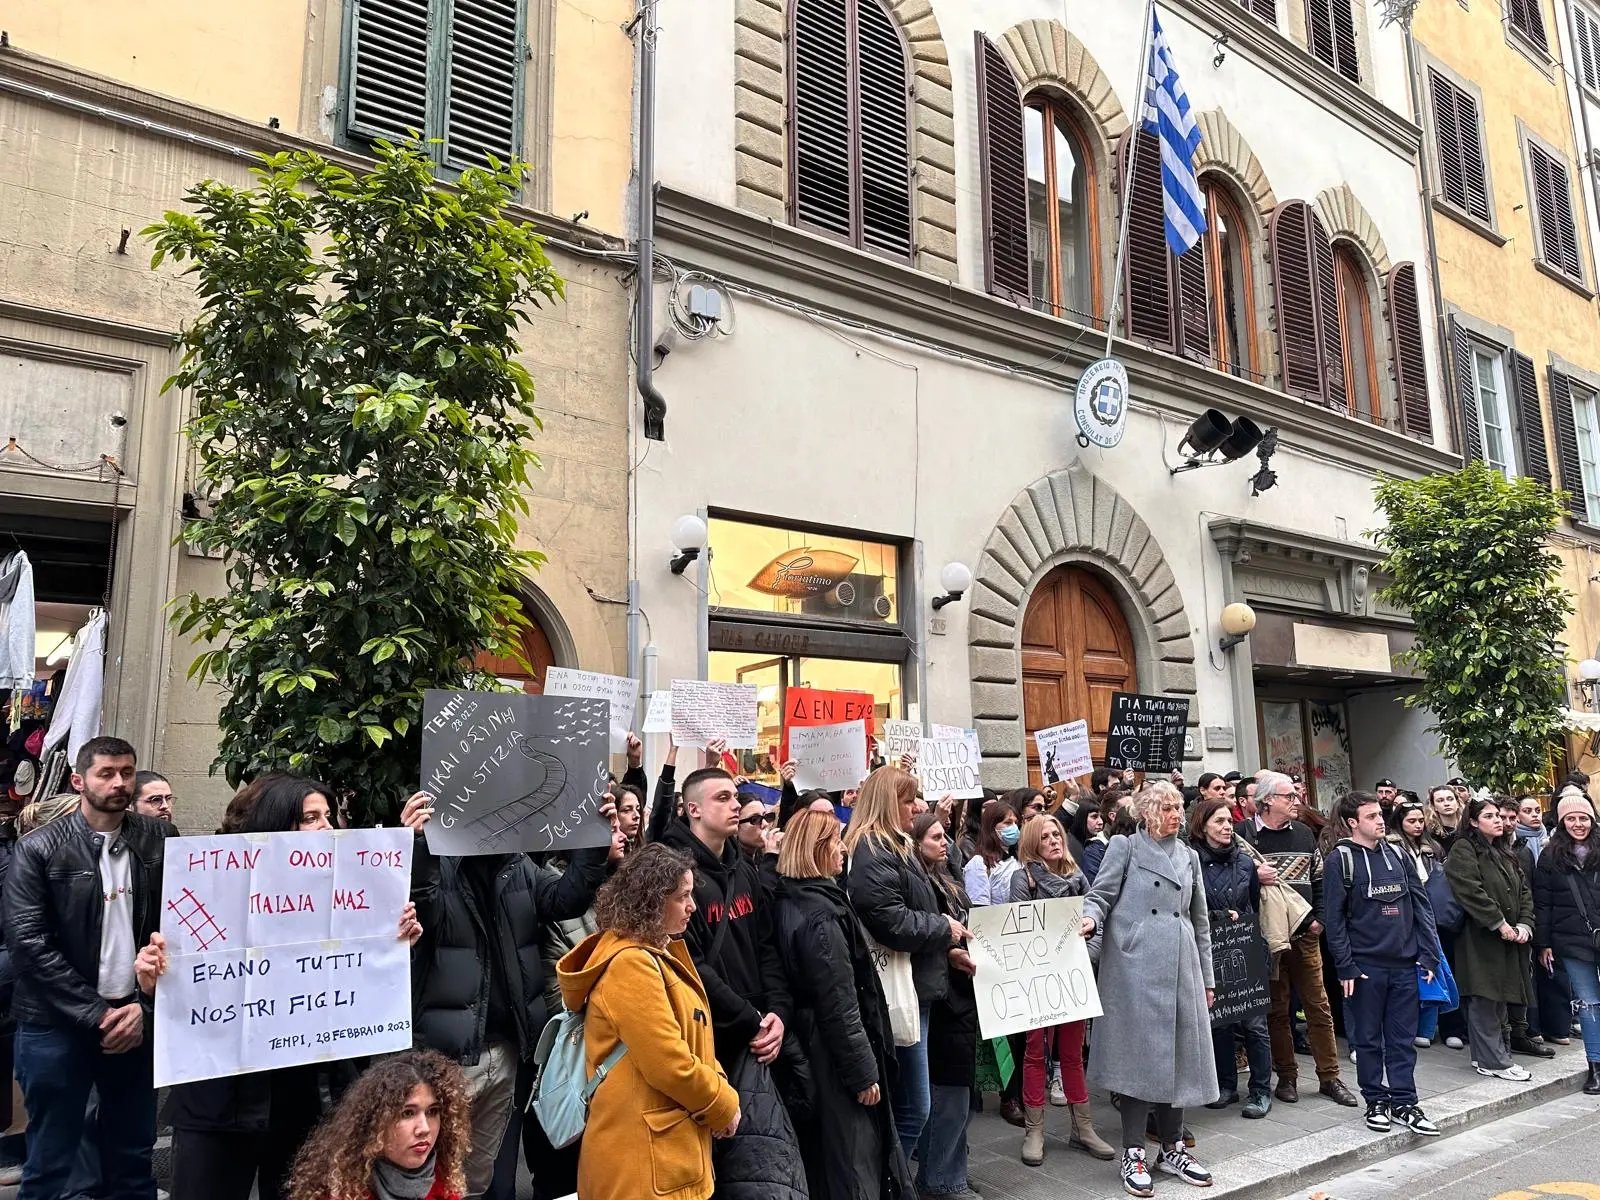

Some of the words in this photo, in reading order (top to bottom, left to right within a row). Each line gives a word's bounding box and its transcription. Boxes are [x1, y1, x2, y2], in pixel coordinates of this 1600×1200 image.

[1079, 361, 1110, 395] ΠΡΟΞΕΝΕΙΟ
[1077, 409, 1103, 442] CONSULAT
[1104, 437, 1113, 445] DE
[548, 670, 568, 679] ΕΝΑ
[424, 693, 466, 735] ΤΕΜΠΗ
[451, 719, 464, 733] 28
[461, 708, 472, 722] 02
[468, 700, 479, 713] 23
[793, 697, 834, 720] ΔΕΝ
[1119, 697, 1141, 710] ΓΙΑ
[1145, 700, 1166, 712] ΠΑΝΤΑ
[1126, 712, 1153, 723] ΕΤΟΥΤΗ
[1111, 725, 1136, 737] ΔΙΚΑ
[946, 742, 969, 764] HO
[1109, 757, 1122, 768] ΤΑ
[440, 729, 524, 829] GIUSTIZIA
[539, 760, 609, 850] JUSTICE
[189, 849, 261, 872] ΗΤΑΝ
[289, 849, 333, 868] ΟΛΟΙ
[357, 849, 404, 868] ΤΟΥΣ
[249, 893, 315, 914] ΠΑΙΔΙΑ
[333, 888, 371, 910] ΜΑΣ
[1001, 902, 1046, 936] ΔΕΝ
[192, 958, 271, 983] ERANO
[296, 952, 364, 974] TUTTI
[1002, 935, 1050, 972] ΕΧΩ
[191, 999, 276, 1025] NOSTRI
[288, 990, 355, 1015] FIGLI
[991, 968, 1088, 1020] ΟΞΥΓΟΝΟ
[268, 1033, 311, 1050] TEMPI,
[316, 1032, 331, 1044] 28
[331, 1024, 385, 1043] FEBBRAIO
[387, 1020, 411, 1033] 2023
